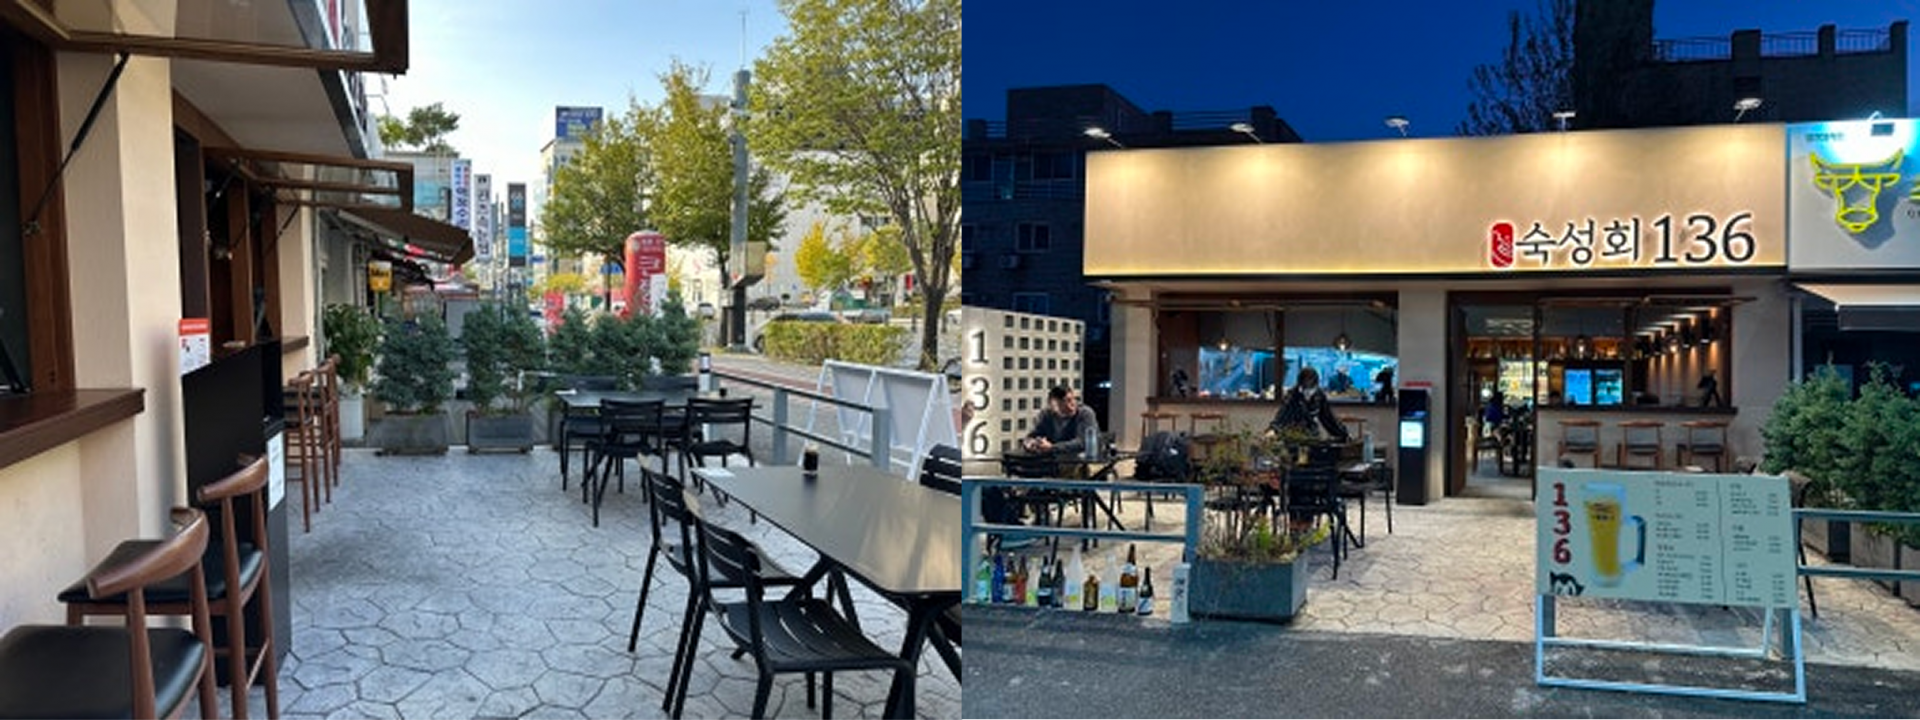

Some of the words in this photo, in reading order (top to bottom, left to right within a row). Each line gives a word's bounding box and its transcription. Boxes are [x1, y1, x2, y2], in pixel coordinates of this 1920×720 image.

[1516, 217, 1641, 265] 숙성회
[1653, 213, 1756, 264] 136
[969, 328, 991, 456] 136
[1552, 482, 1571, 564] 136
